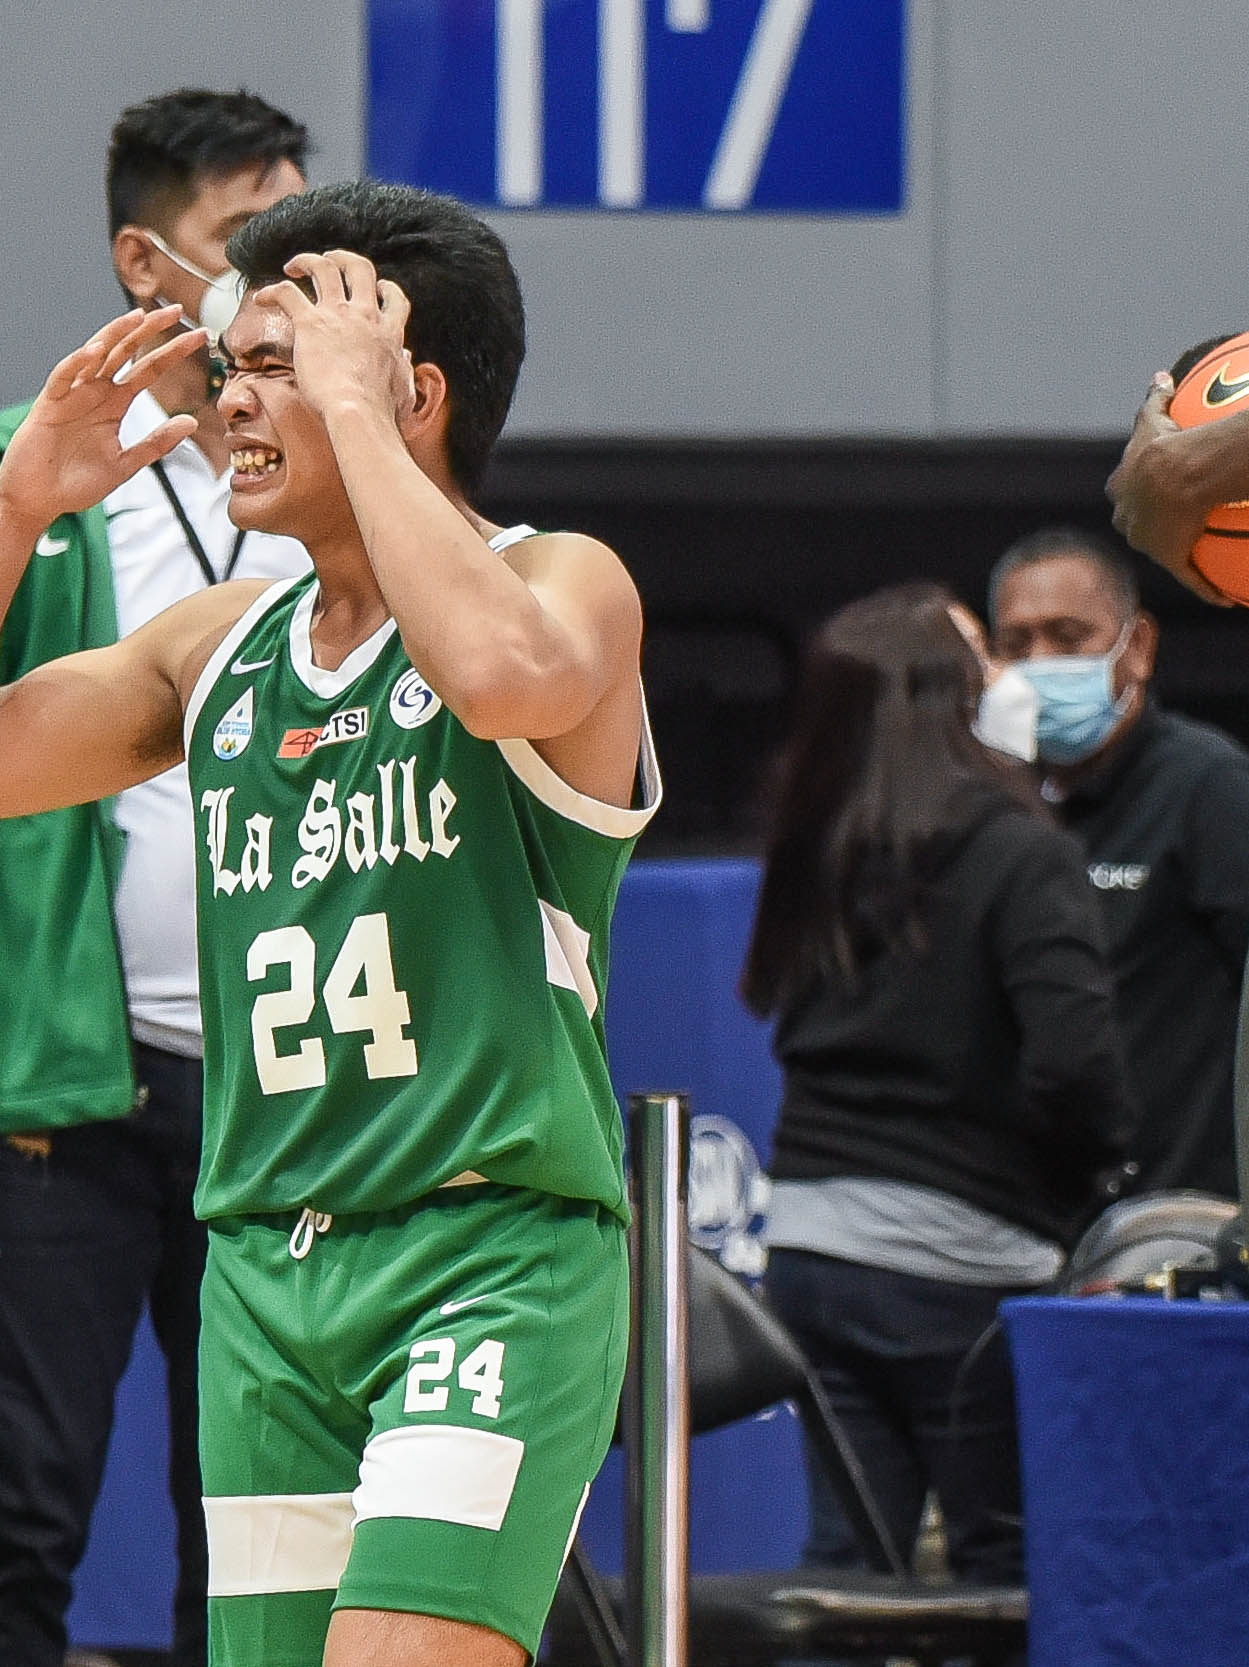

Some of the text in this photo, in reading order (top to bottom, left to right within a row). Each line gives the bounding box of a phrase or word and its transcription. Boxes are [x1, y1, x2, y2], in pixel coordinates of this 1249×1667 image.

[495, 0, 813, 209] 117
[200, 755, 460, 898] La Salle
[246, 912, 418, 1095] 24
[404, 1337, 505, 1419] 24
